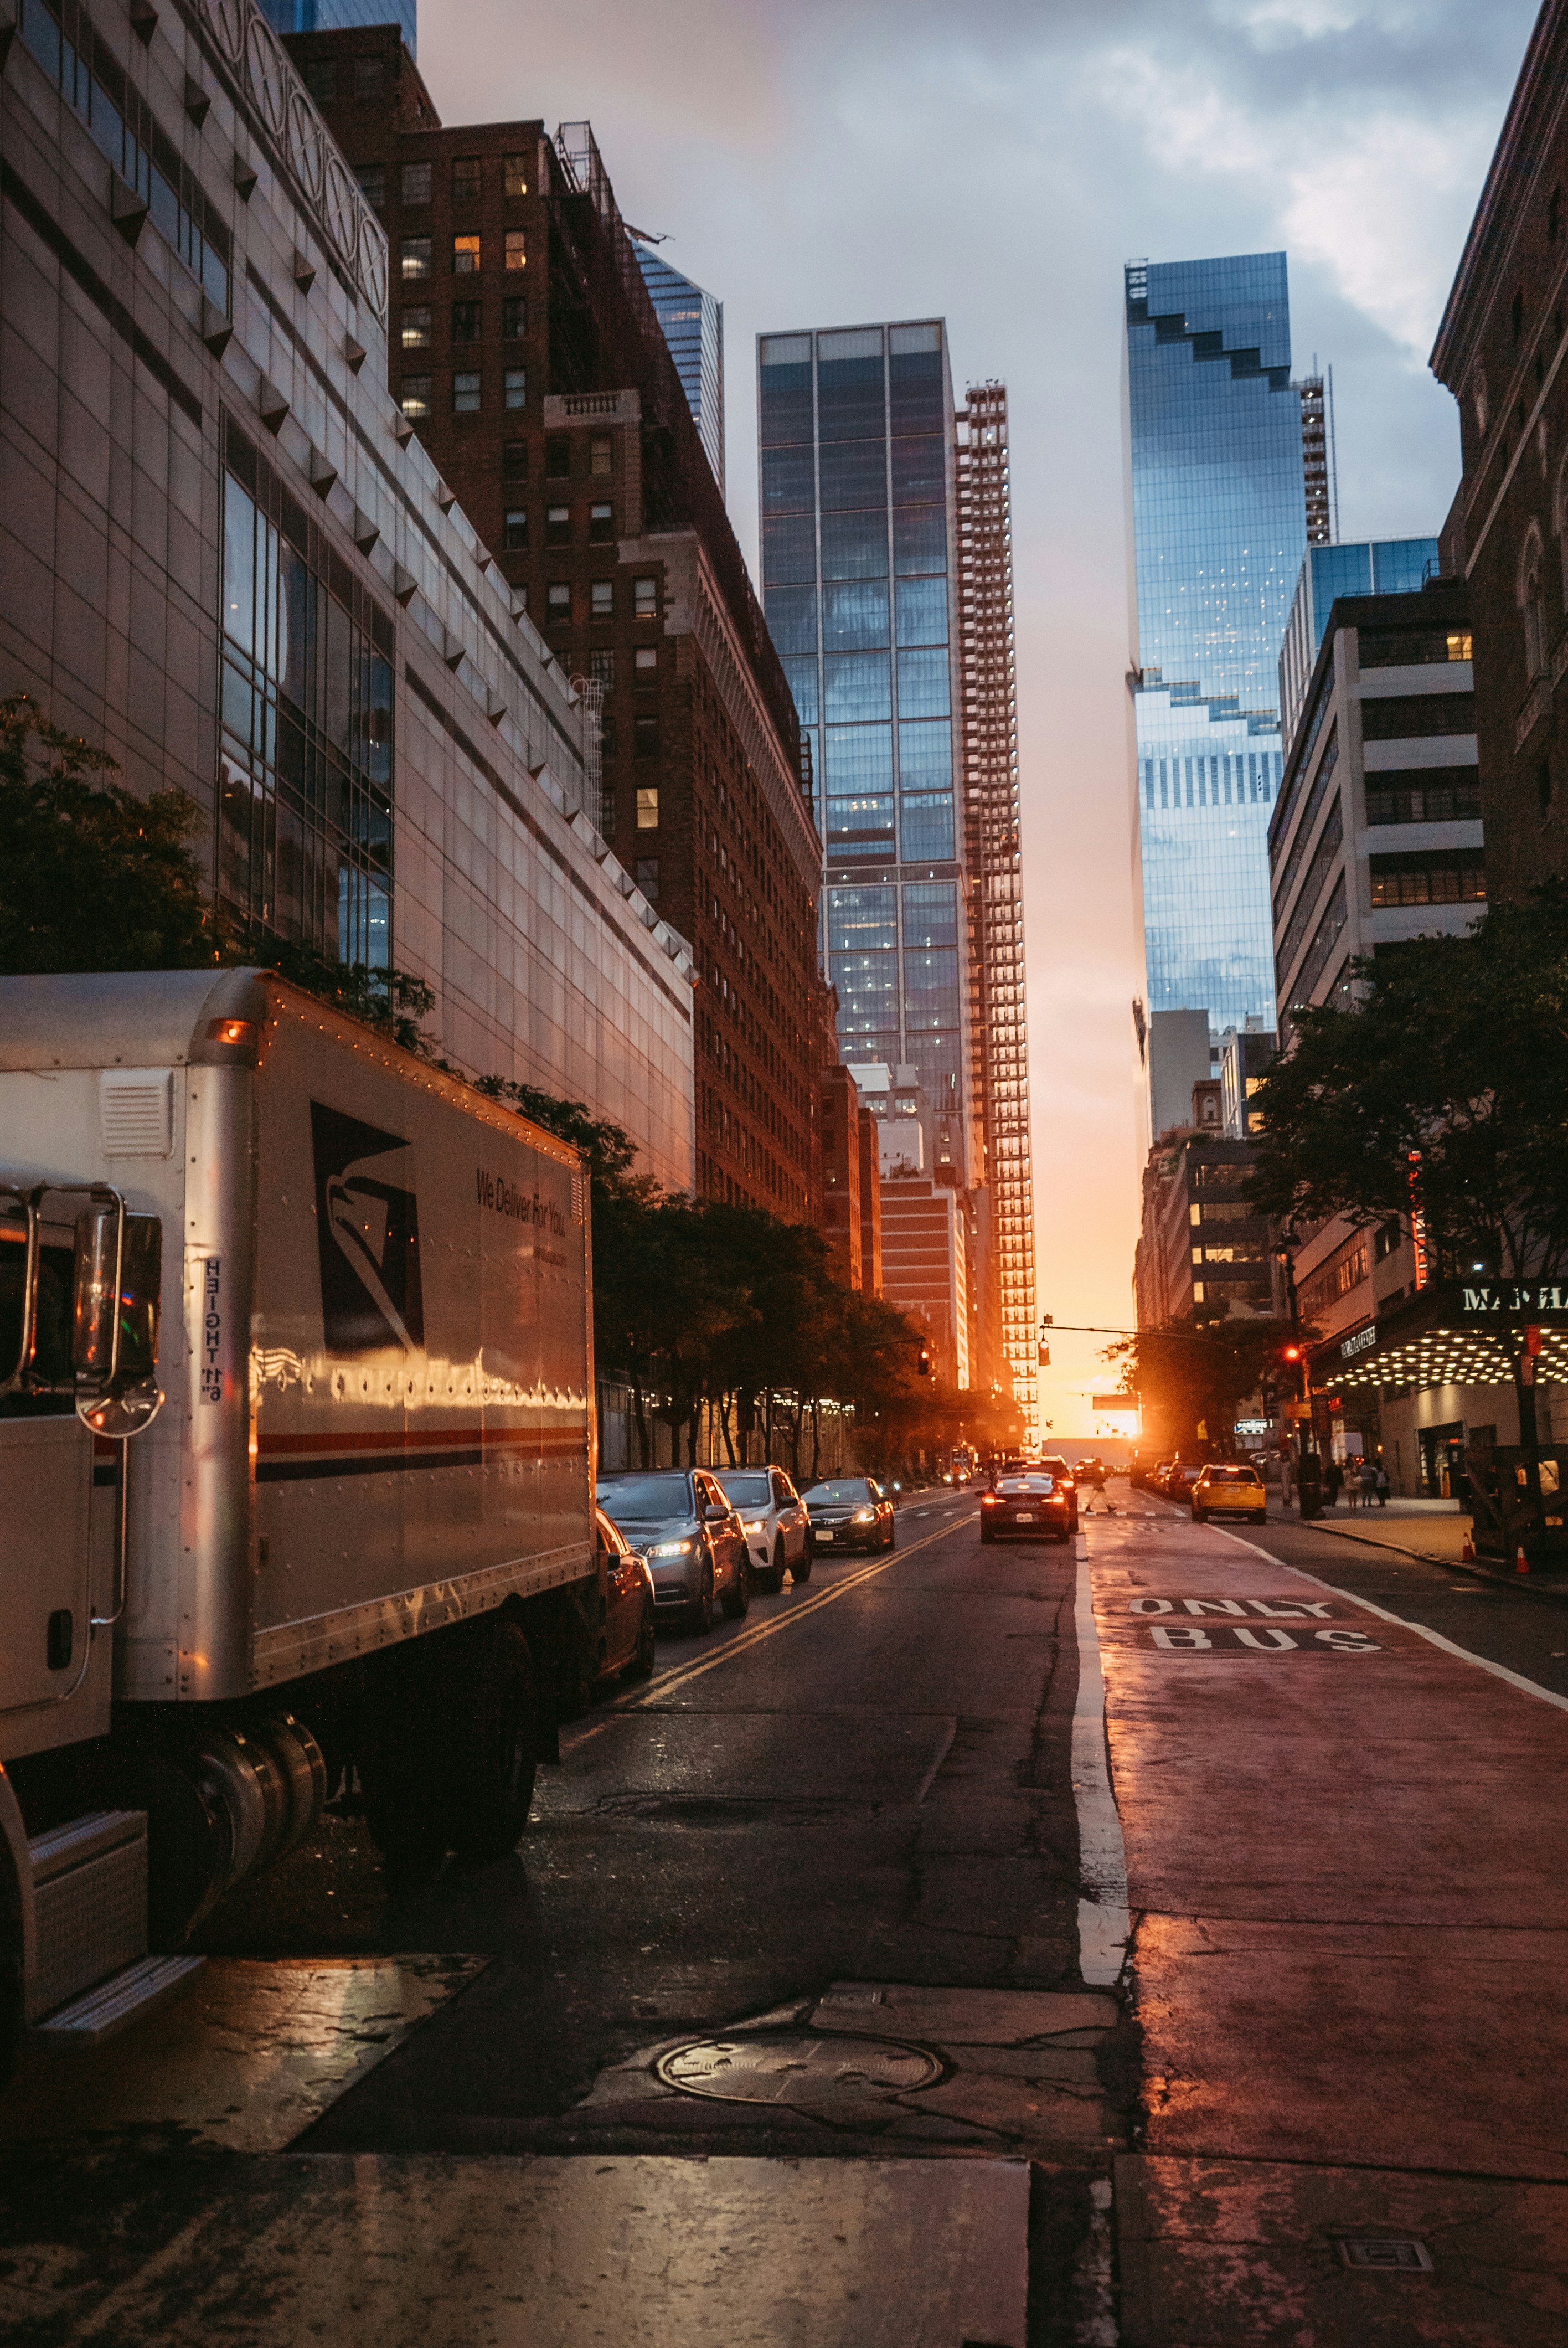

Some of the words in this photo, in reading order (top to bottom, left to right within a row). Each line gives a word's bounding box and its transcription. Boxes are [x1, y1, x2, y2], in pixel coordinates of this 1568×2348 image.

[477, 1168, 494, 1209] We
[496, 1177, 531, 1222] Deliver
[532, 1193, 549, 1229] For
[1128, 1598, 1333, 1619] ONLY
[1149, 1626, 1382, 1652] BUS
